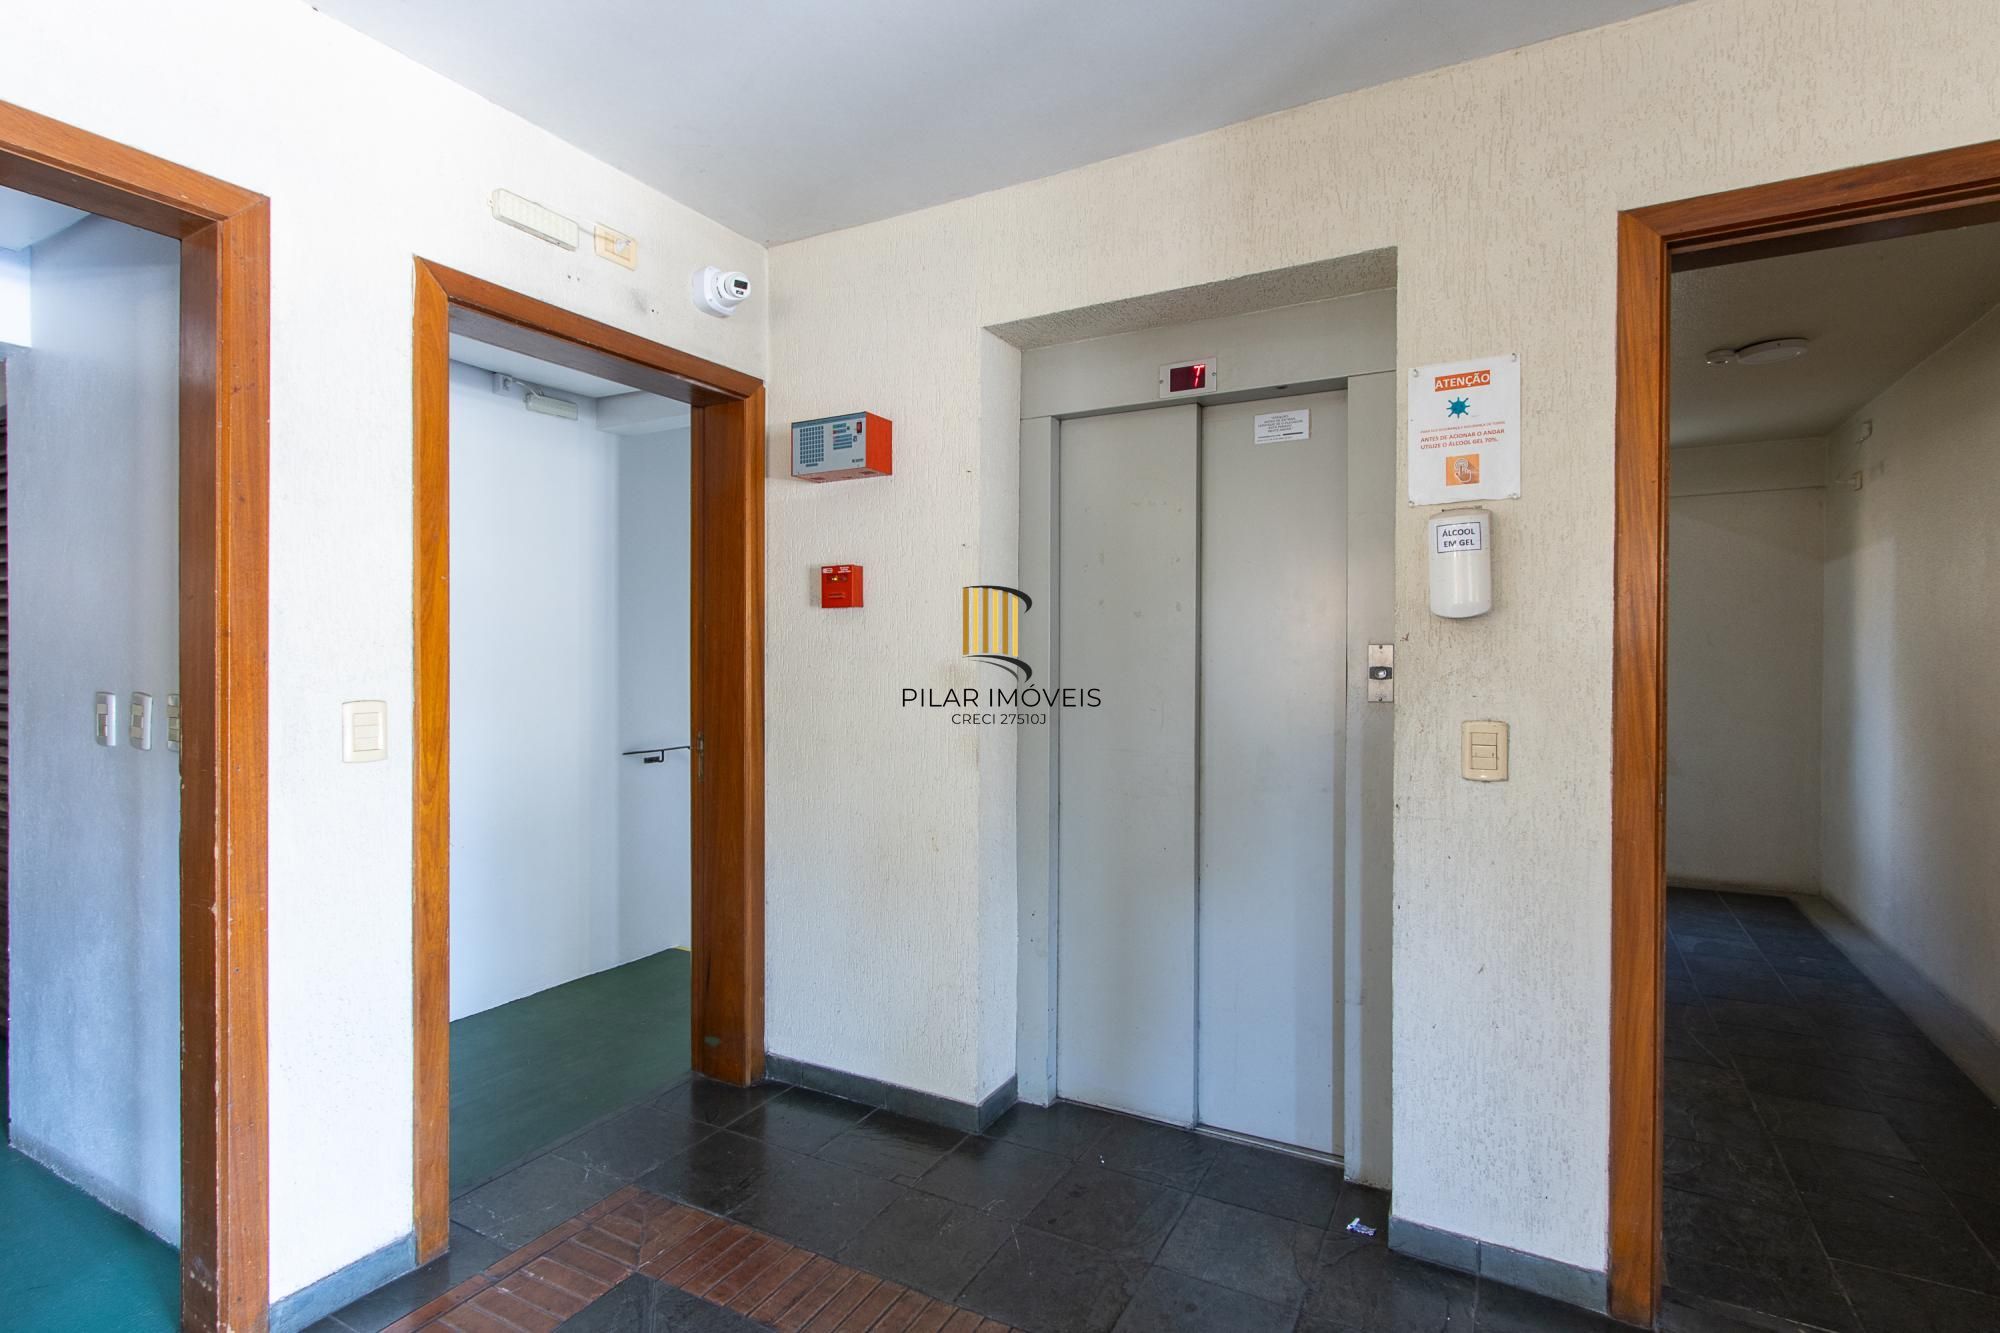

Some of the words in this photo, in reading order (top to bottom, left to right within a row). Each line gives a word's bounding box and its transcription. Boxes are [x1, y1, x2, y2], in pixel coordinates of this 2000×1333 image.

[1193, 364, 1205, 388] 7
[1435, 372, 1490, 389] ATENÇÃO
[1448, 432, 1476, 440] ACIONAR
[1483, 428, 1505, 436] ANDAR
[1420, 442, 1441, 450] UTILIZE
[1443, 540, 1457, 548] EM
